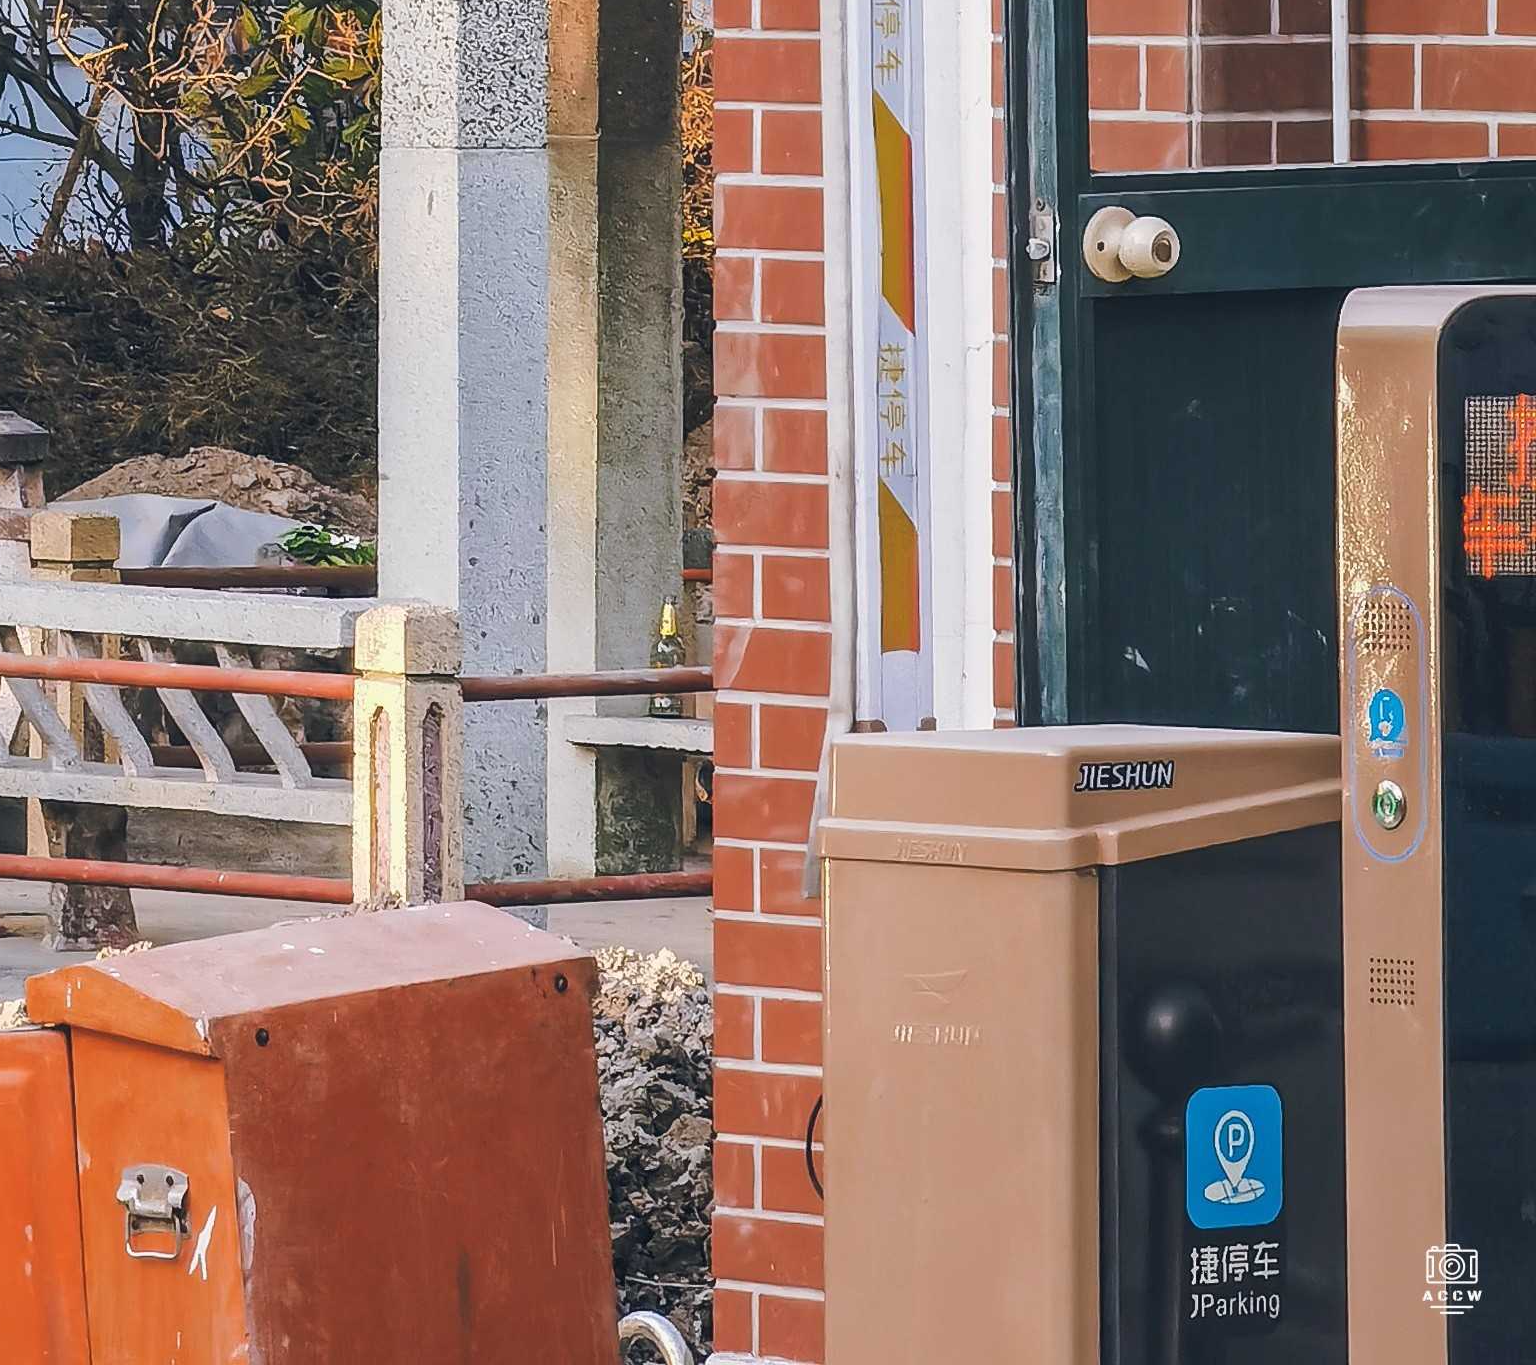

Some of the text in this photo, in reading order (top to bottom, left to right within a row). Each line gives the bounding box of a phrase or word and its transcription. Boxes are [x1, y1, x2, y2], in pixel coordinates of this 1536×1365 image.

[879, 342, 907, 477] 捷停车
[1075, 762, 1173, 789] JIESHUN
[1228, 1122, 1245, 1158] P
[1190, 1240, 1280, 1285] 捷停车
[1190, 1290, 1281, 1319] JParking
